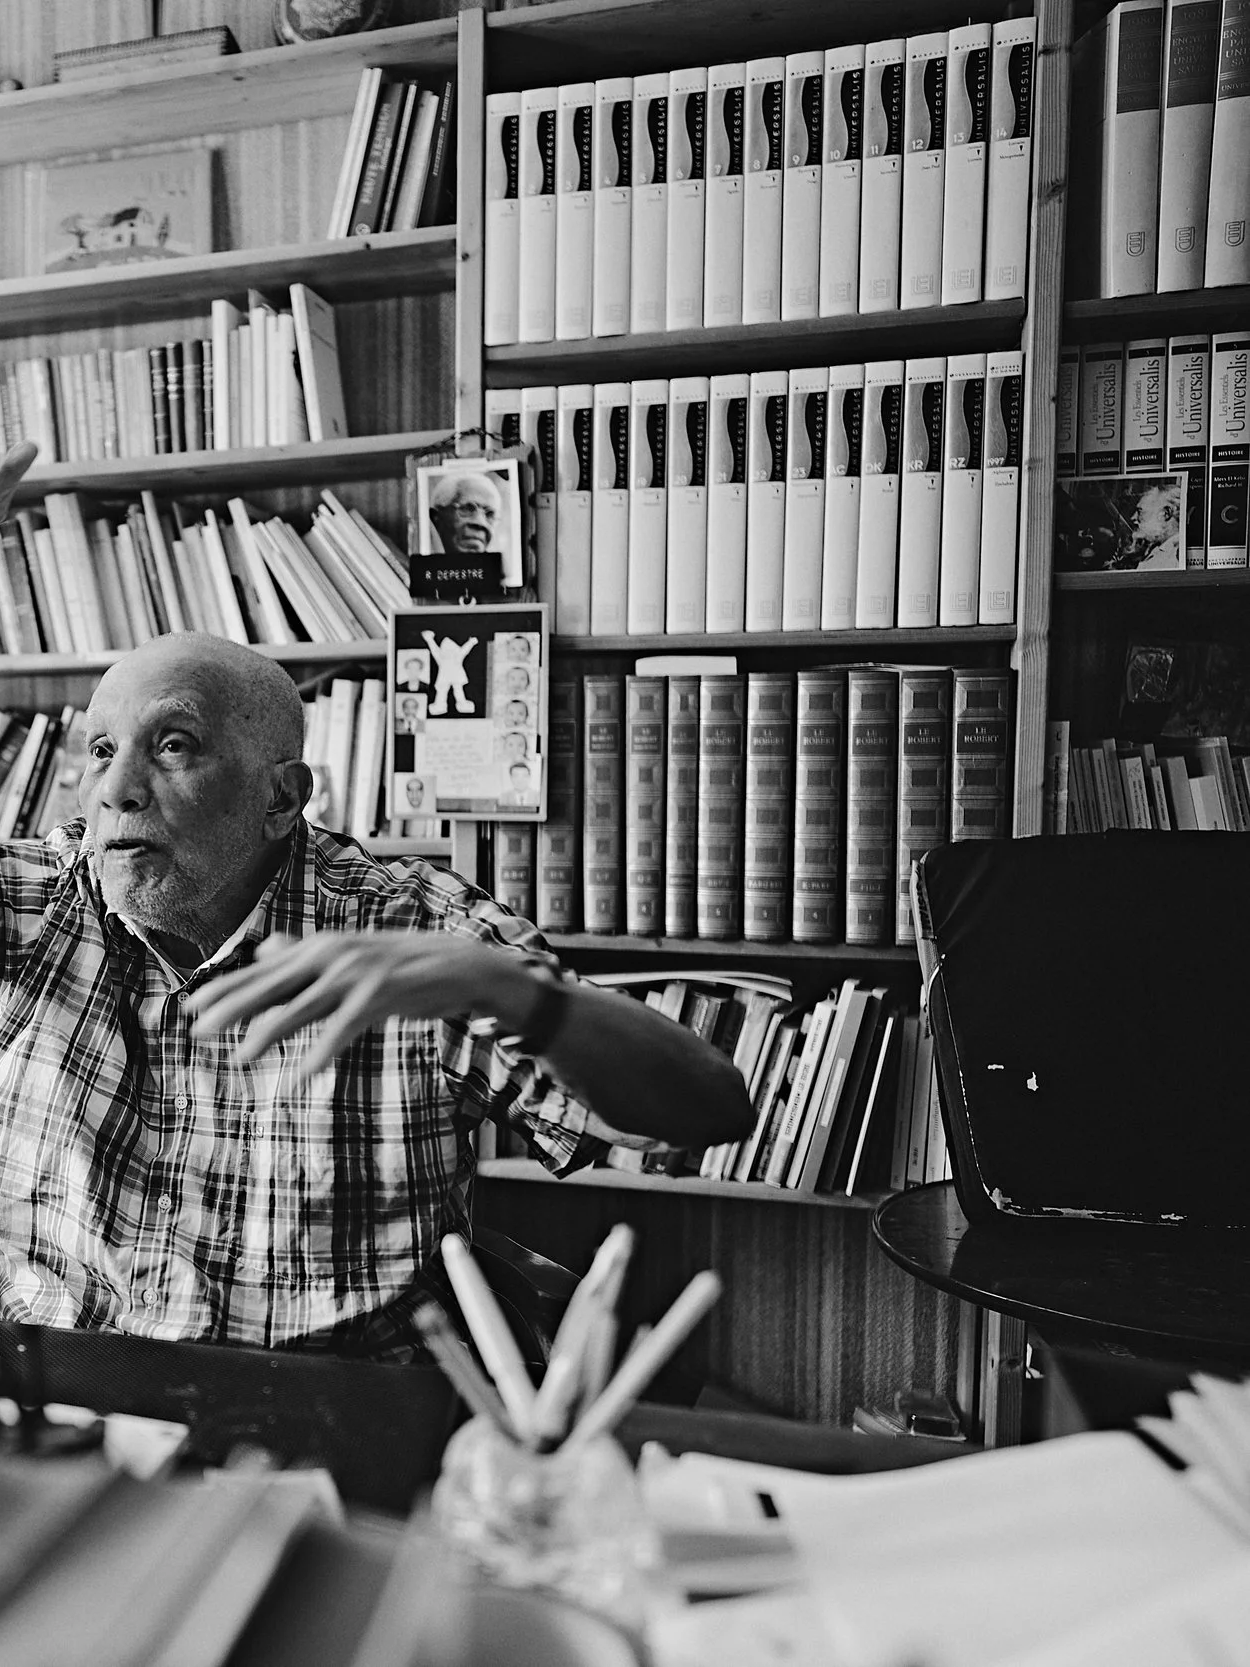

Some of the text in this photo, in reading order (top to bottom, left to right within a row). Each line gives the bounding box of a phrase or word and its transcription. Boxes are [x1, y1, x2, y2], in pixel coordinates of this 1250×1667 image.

[976, 51, 986, 139] UNIVERSALIS
[1019, 46, 1030, 135] UNIVERSALIS
[891, 65, 901, 152] UNIVERSALIS
[935, 59, 944, 146] UNIVERSALIS
[811, 78, 821, 163] UNIVERSALIS
[850, 71, 861, 157] UNIVERSALIS
[772, 83, 781, 167] UNIVERSALIS
[954, 132, 965, 143] 13
[996, 128, 1008, 138] 14
[870, 145, 879, 155] 11
[912, 139, 924, 150] 12
[792, 154, 800, 165] 9
[830, 150, 841, 161] 10
[714, 164, 722, 175] 7
[753, 160, 761, 170] 8
[1176, 377, 1185, 419] Les Essentiels
[1219, 374, 1228, 417] Les Essentiels
[1011, 378, 1020, 464] UNIVERSALIS
[1133, 408, 1141, 421] Les
[931, 384, 941, 469] UNIVERSALIS
[971, 381, 982, 466] UNIVERSALIS
[950, 457, 966, 468] RZ
[988, 457, 1004, 466] 1997
[1221, 505, 1239, 524] C
[425, 568, 484, 581] R DEPESTRE
[803, 737, 835, 745] ROBERT
[854, 737, 888, 745] ROBERT
[907, 736, 942, 745] ROBERT
[964, 735, 999, 743] ROBERT
